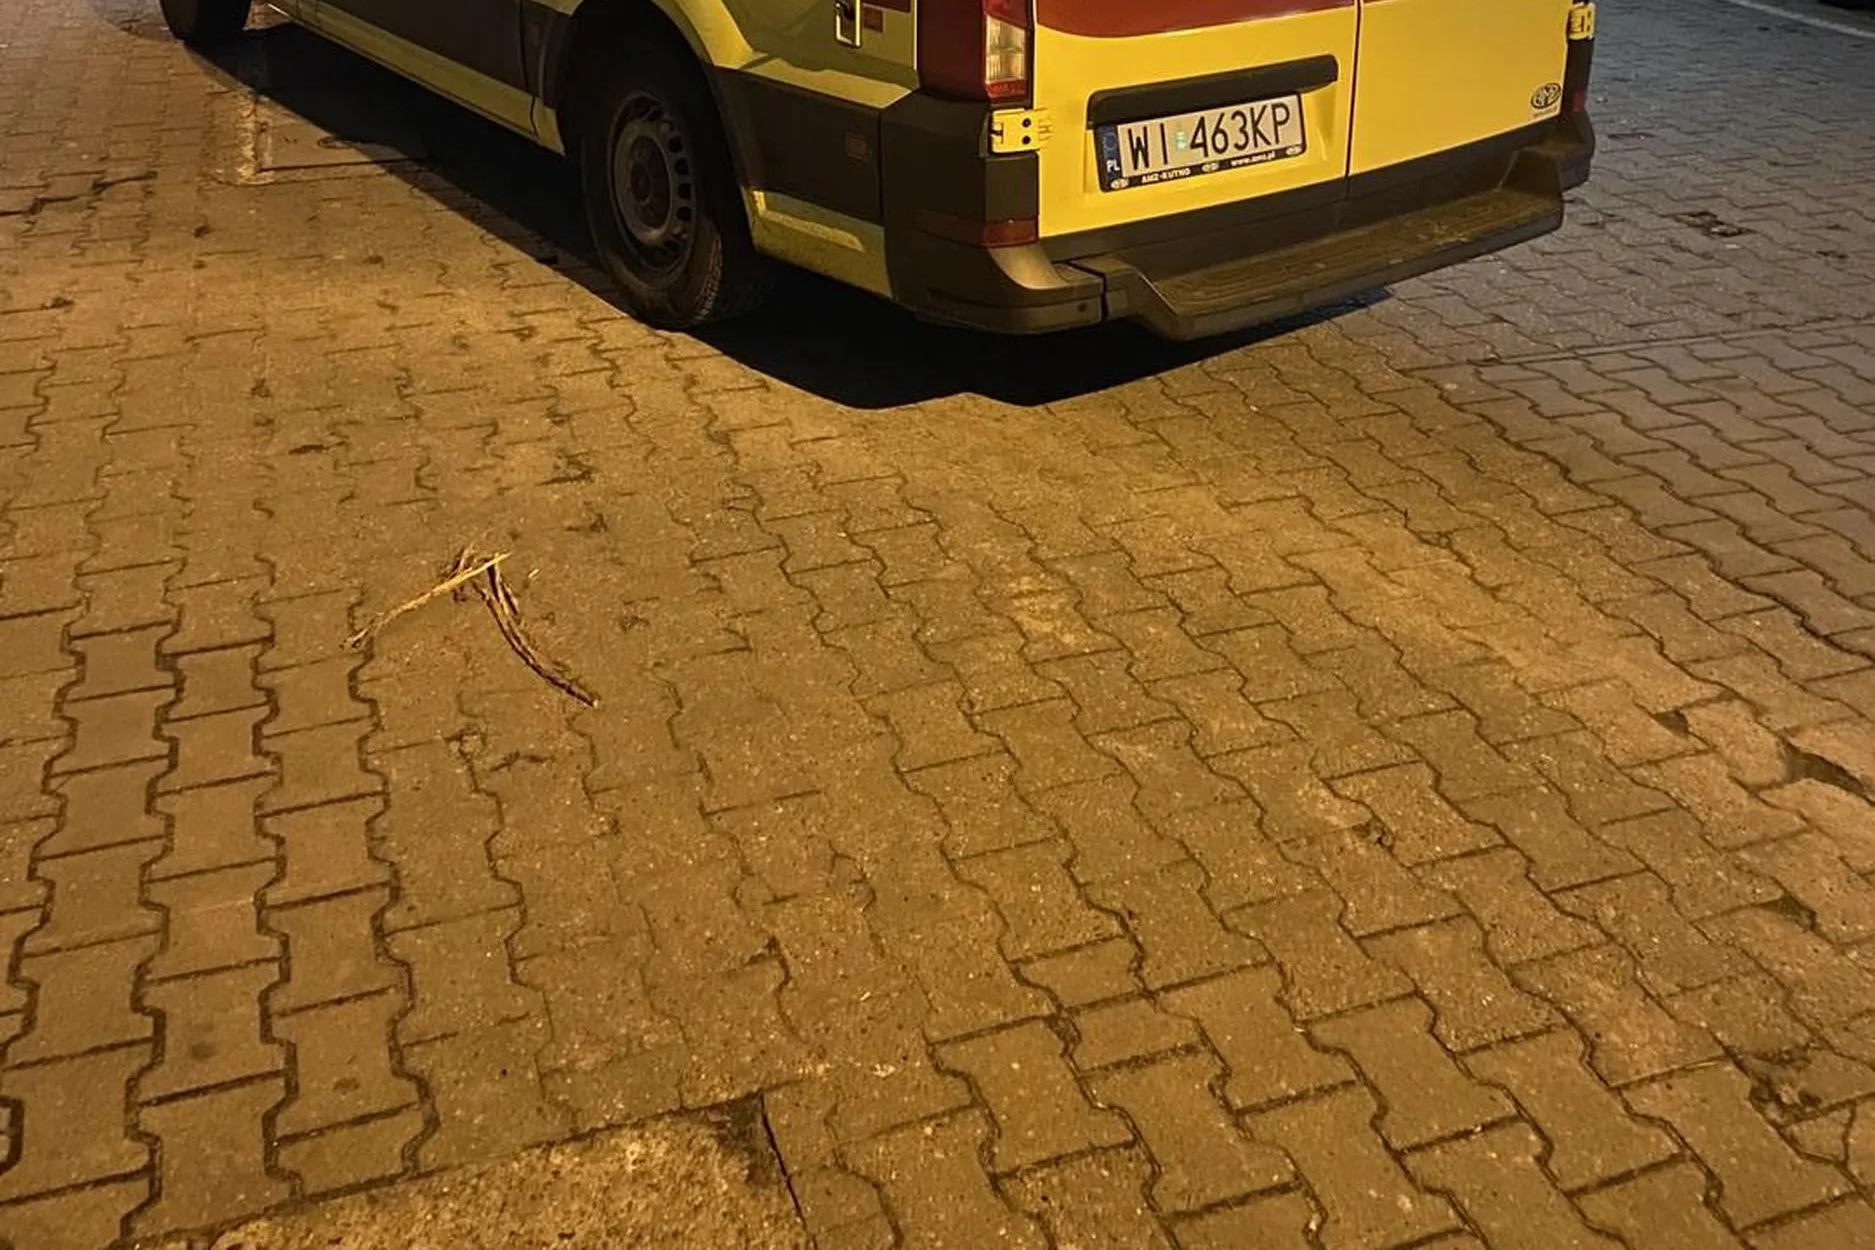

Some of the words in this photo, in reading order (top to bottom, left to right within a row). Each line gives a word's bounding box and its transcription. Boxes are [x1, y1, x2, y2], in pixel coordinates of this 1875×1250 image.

[1128, 123, 1169, 171] WI
[1189, 103, 1290, 158] 463KP
[1106, 159, 1120, 172] PL
